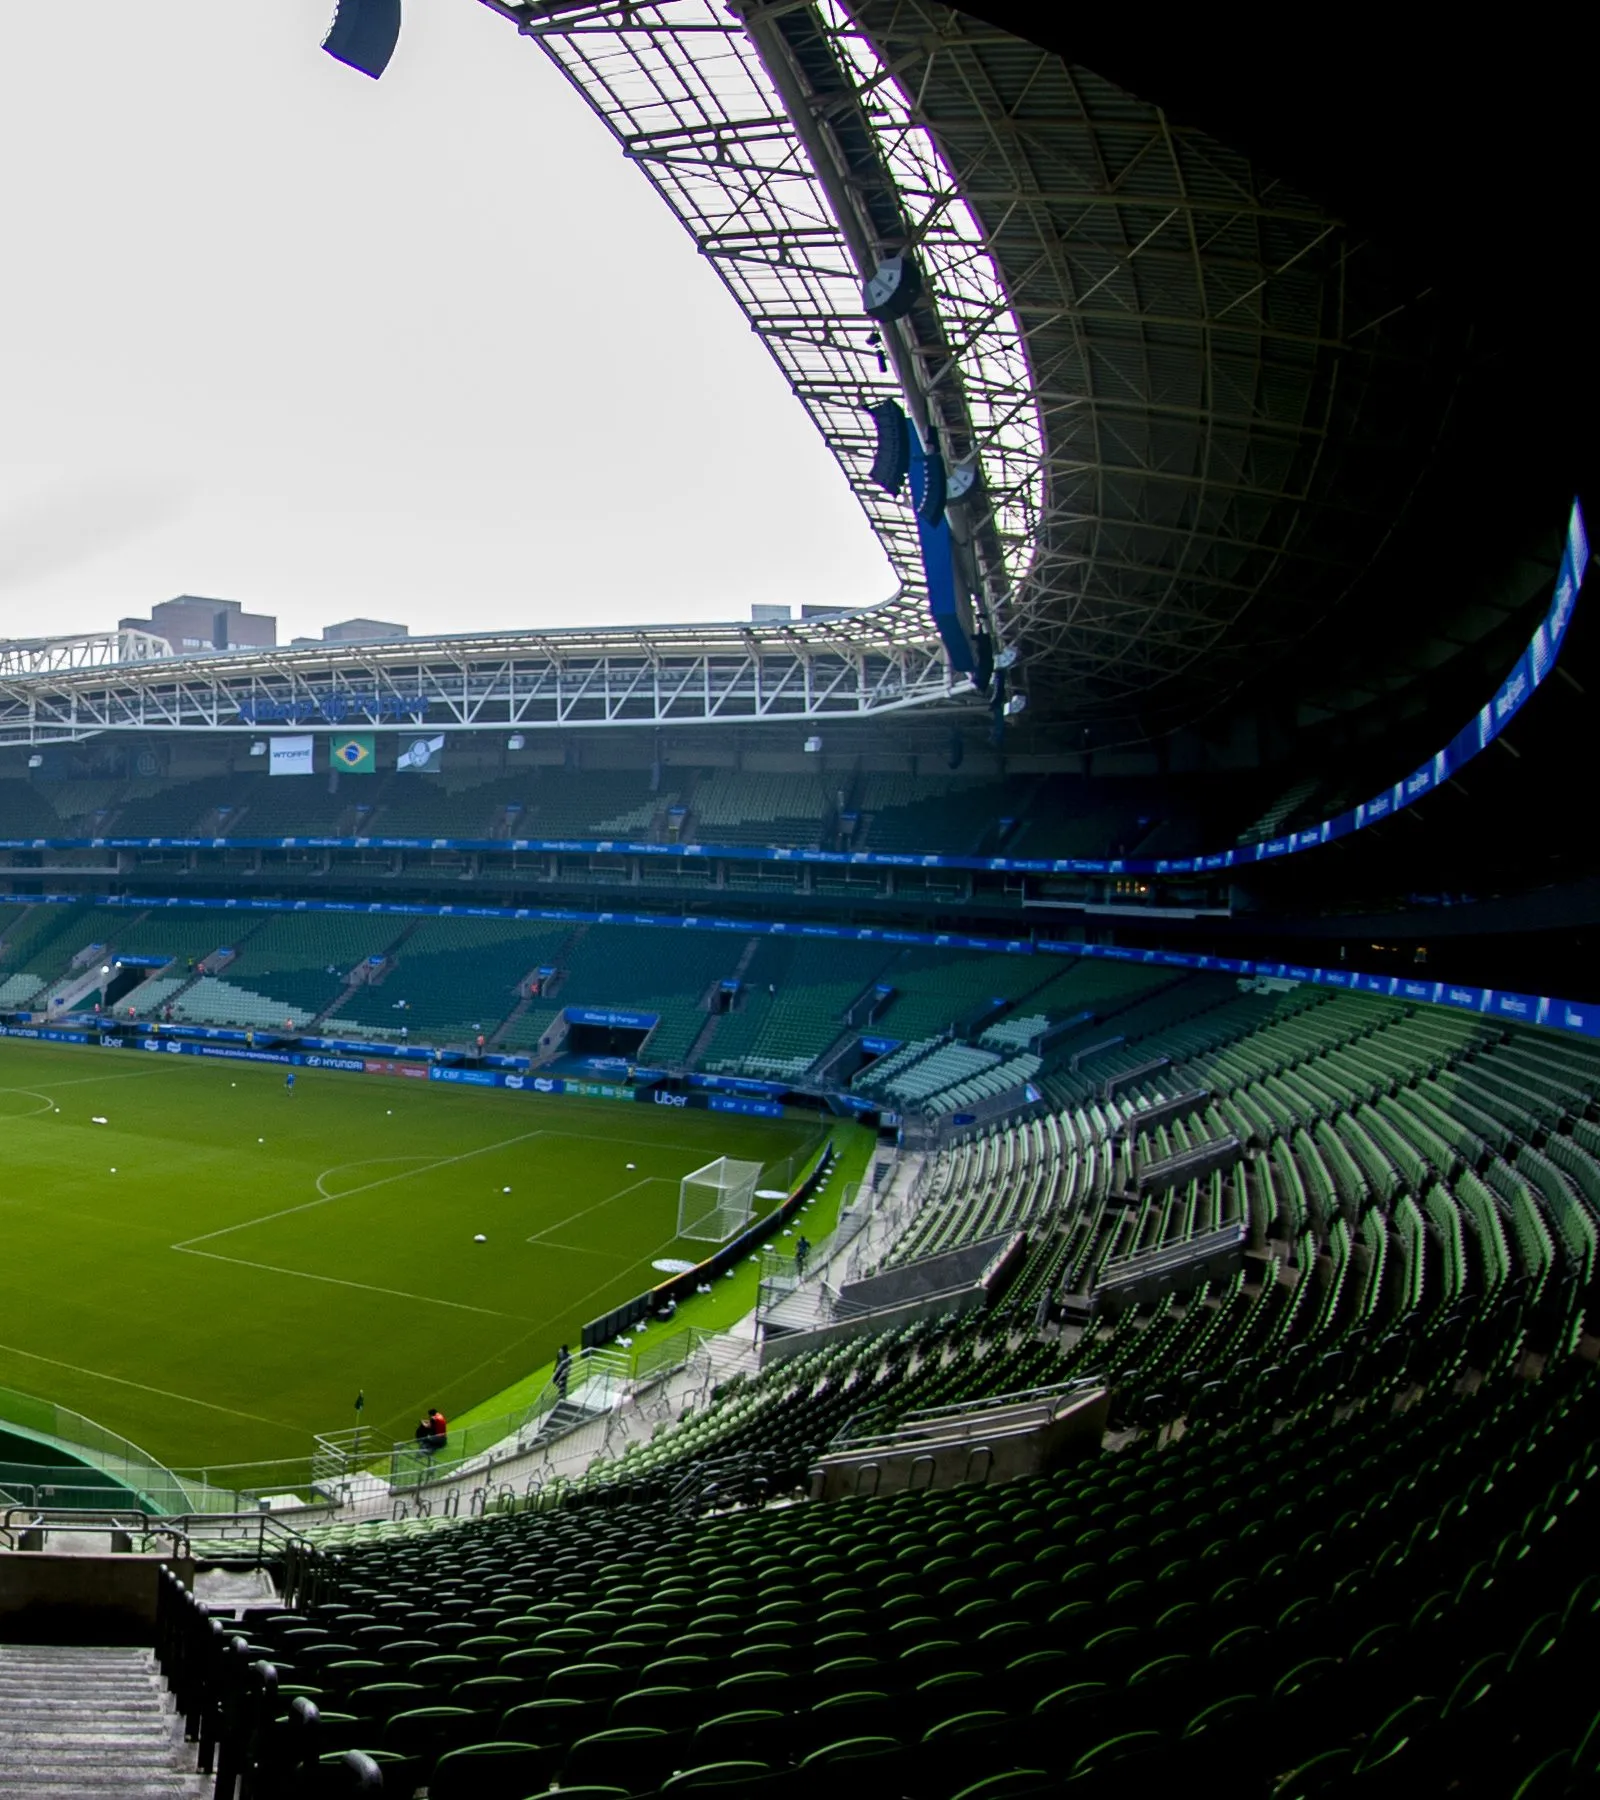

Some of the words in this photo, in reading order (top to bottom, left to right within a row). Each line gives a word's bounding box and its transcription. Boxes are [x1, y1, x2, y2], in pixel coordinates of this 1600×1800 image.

[238, 699, 313, 721] Allianz
[353, 691, 430, 720] Parque
[272, 749, 311, 759] WTORRE
[100, 1036, 123, 1048] Uber
[322, 1058, 363, 1070] HYUNDAI
[654, 1090, 689, 1108] Uber
